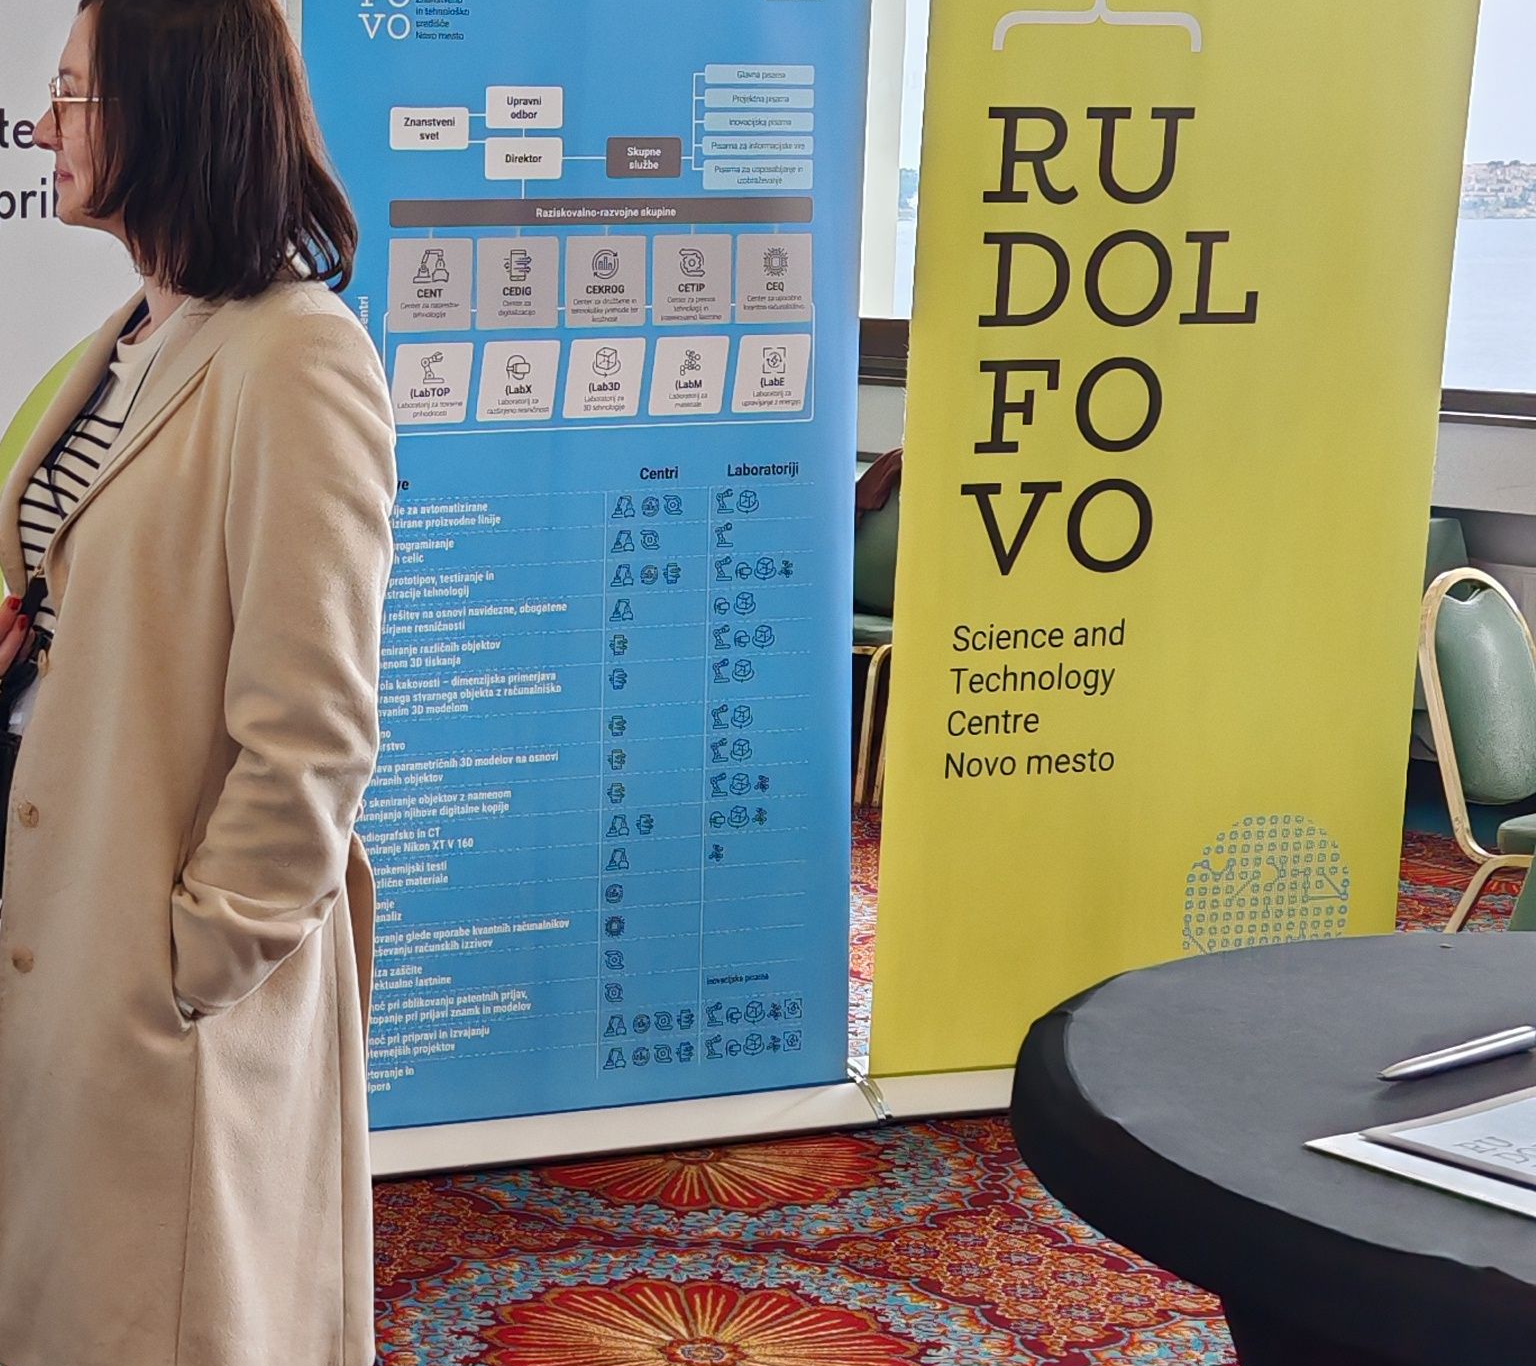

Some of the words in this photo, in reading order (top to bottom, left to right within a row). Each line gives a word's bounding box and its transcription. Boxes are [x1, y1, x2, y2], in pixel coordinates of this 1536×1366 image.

[358, 13, 412, 40] VO
[506, 96, 542, 107] Upravni
[510, 110, 538, 120] odbor
[404, 117, 456, 128] Znanstveni
[419, 131, 440, 140] svet
[505, 153, 542, 164] Direktor
[627, 146, 662, 159] Skupne
[983, 106, 1196, 205] RU
[629, 160, 659, 170] službe
[535, 207, 639, 220] Raziskovalno-razvojne
[640, 207, 677, 219] skupine
[978, 229, 1259, 328] DOL
[416, 288, 444, 298] CENT
[502, 286, 532, 297] CEDIG
[586, 284, 625, 295] CEKROG
[677, 283, 706, 293] CETIP
[766, 281, 785, 292] CEQ
[974, 356, 1163, 455] FO
[640, 466, 679, 480] Centri
[727, 462, 799, 480] Laboratoriji
[960, 478, 1153, 577] VO
[394, 538, 454, 552] rogramiranje
[386, 588, 421, 601] stracije
[952, 623, 1064, 652] Science
[1073, 617, 1126, 648] and
[381, 644, 417, 657] eniranje
[950, 662, 1116, 697] Technology
[379, 694, 411, 705] ranega
[947, 709, 1040, 737] Centre
[380, 741, 406, 751] rstvo
[944, 751, 1017, 780] Novo
[1026, 748, 1115, 775] mesto
[428, 827, 441, 838] CT
[432, 839, 446, 850] XT
[447, 839, 455, 849] V
[457, 838, 474, 849] 160
[374, 862, 425, 876] trokemijski
[376, 877, 404, 889] zlične
[375, 932, 404, 944] ovanje
[374, 979, 414, 992] ektualne
[369, 1012, 403, 1025] topanje
